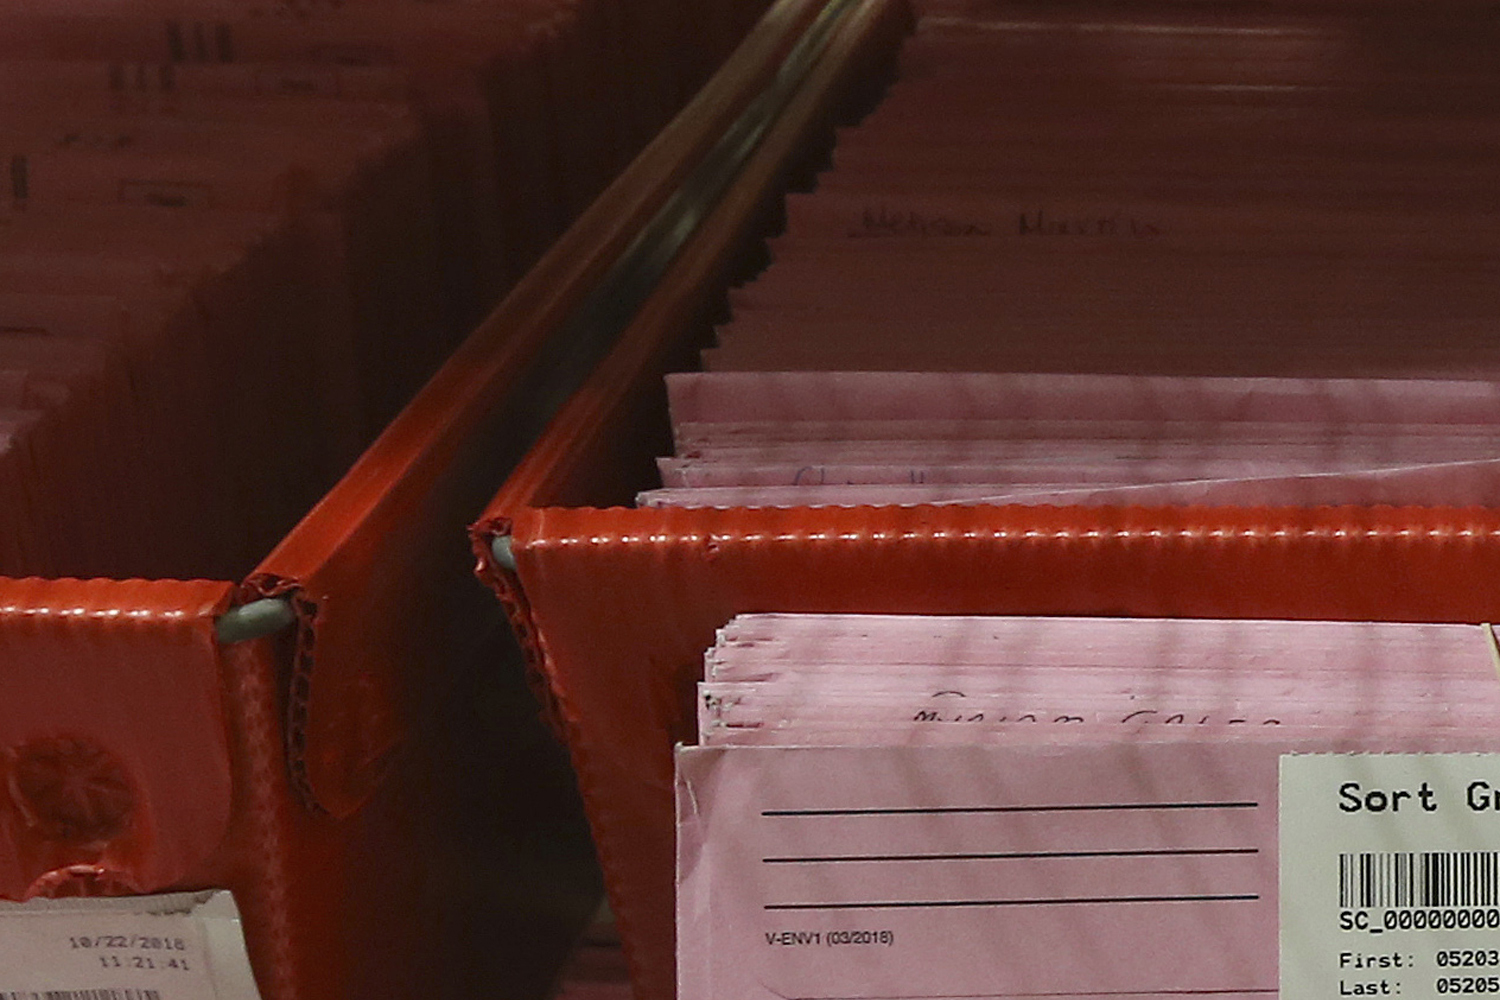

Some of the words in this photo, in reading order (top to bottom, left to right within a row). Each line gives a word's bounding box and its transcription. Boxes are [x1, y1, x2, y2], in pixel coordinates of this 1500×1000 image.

[1339, 781, 1437, 812] Sort
[765, 931, 820, 945] V-ENV1
[826, 930, 894, 948] (03/2018)
[1340, 953, 1416, 969] First:
[1340, 980, 1402, 996] Last:
